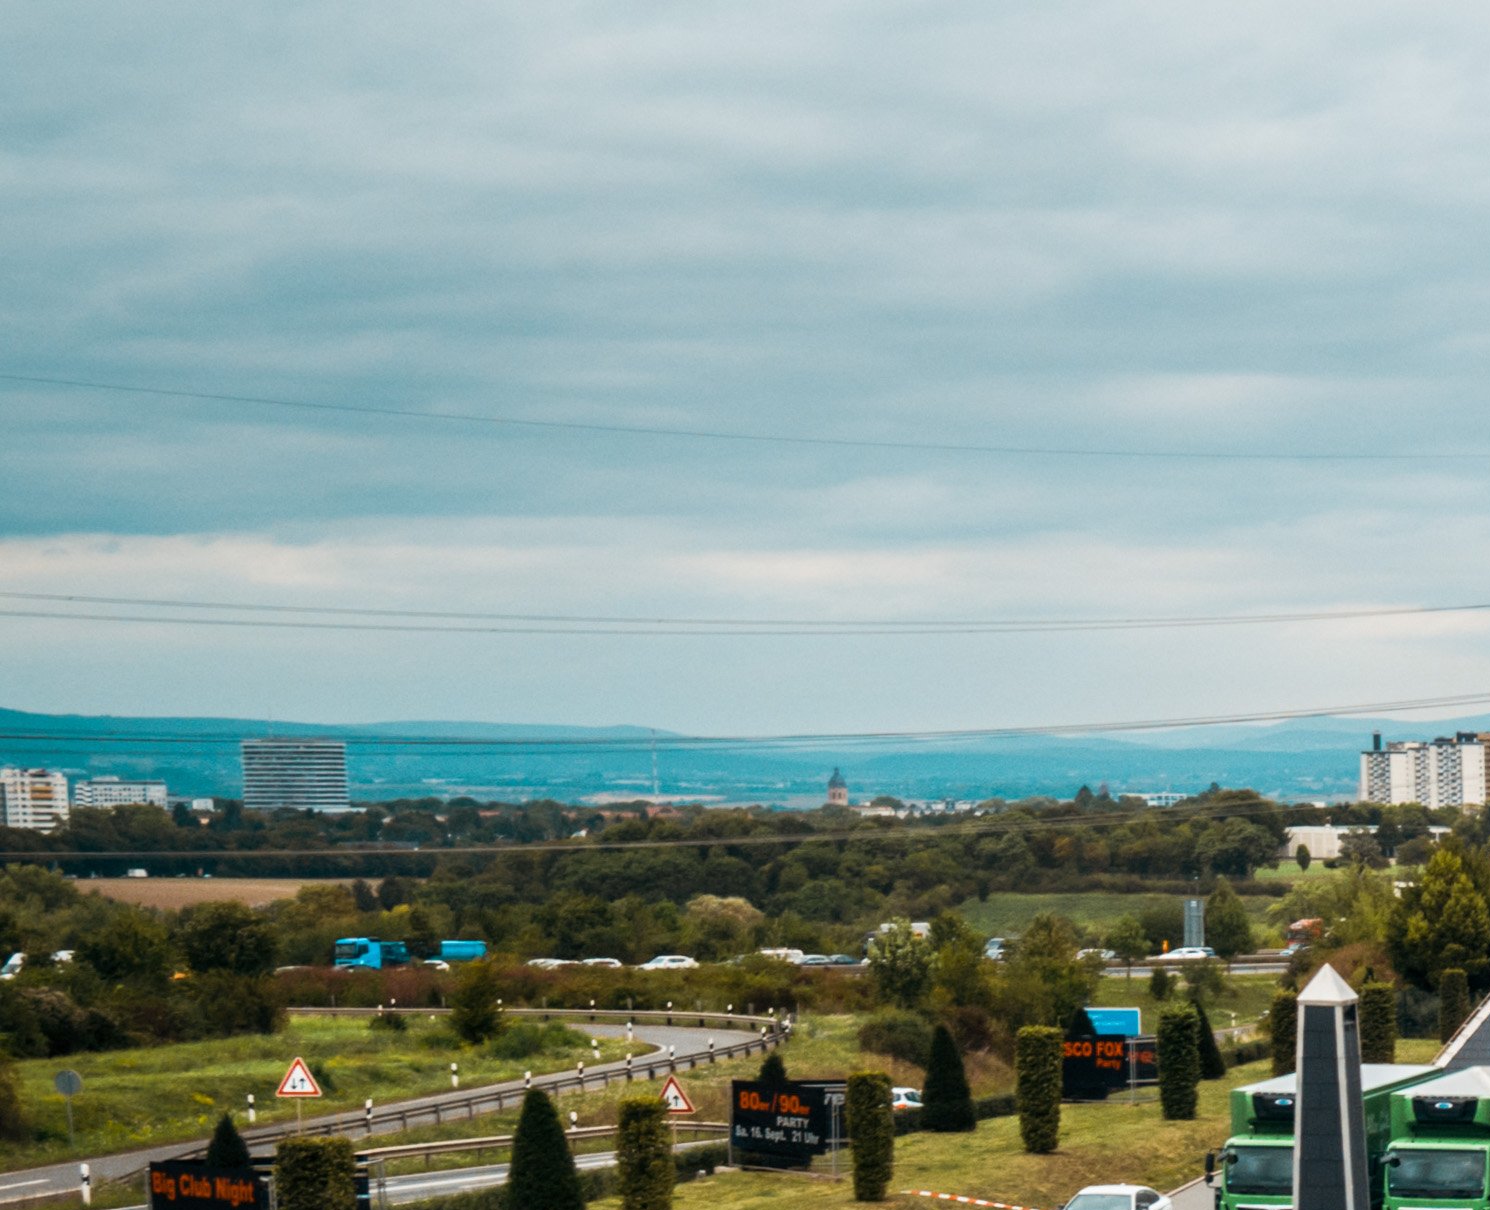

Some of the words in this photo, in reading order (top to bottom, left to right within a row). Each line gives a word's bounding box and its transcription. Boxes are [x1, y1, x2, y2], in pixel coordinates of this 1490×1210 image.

[1063, 1041, 1093, 1058] SCO
[1095, 1041, 1124, 1058] FOX
[776, 1116, 809, 1129] PARTY
[791, 1130, 802, 1143] 21
[804, 1131, 819, 1145] Uhr
[152, 1171, 176, 1200] Big
[178, 1174, 212, 1199] Club
[214, 1177, 256, 1208] Night
